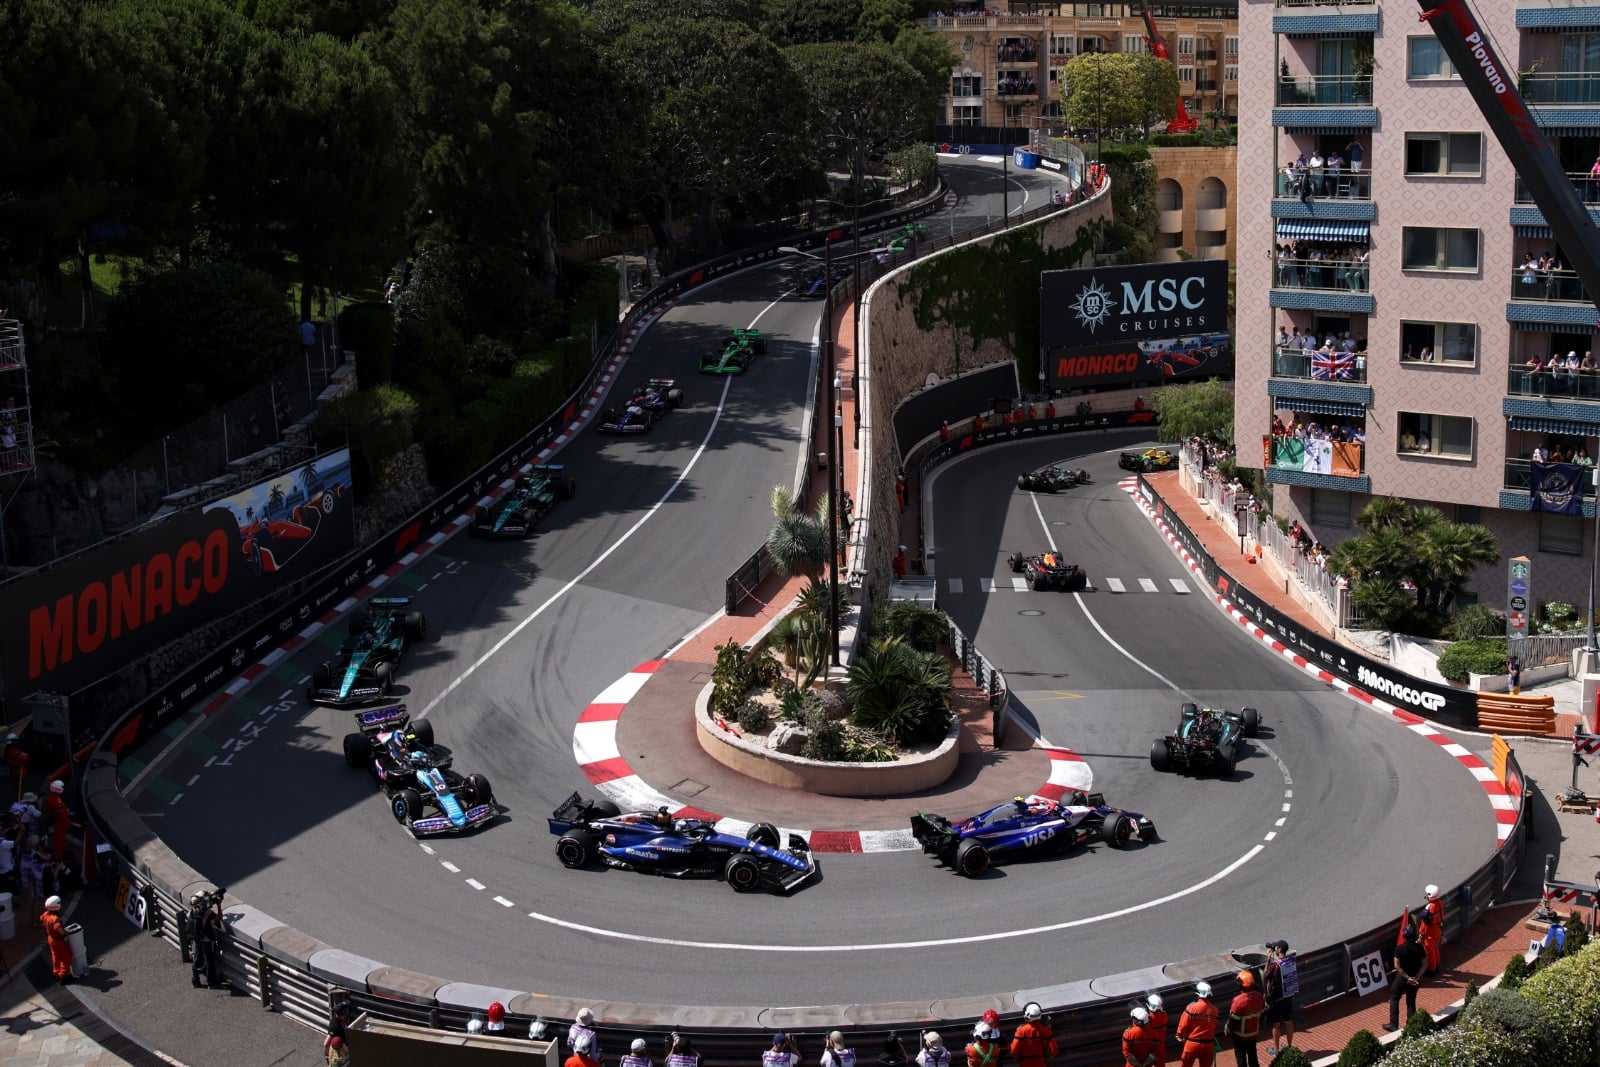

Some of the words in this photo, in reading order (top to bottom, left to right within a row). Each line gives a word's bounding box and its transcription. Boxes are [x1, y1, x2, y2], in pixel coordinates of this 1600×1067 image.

[1465, 31, 1507, 94] Piovano
[1120, 276, 1206, 315] MSC
[1120, 315, 1205, 332] CRUISES
[1057, 352, 1138, 378] MONACO
[29, 529, 229, 680] MONACO
[1357, 665, 1447, 712] #MonacoGP
[1024, 827, 1056, 849] VISA
[128, 893, 144, 922] SC
[1357, 958, 1382, 988] SC
